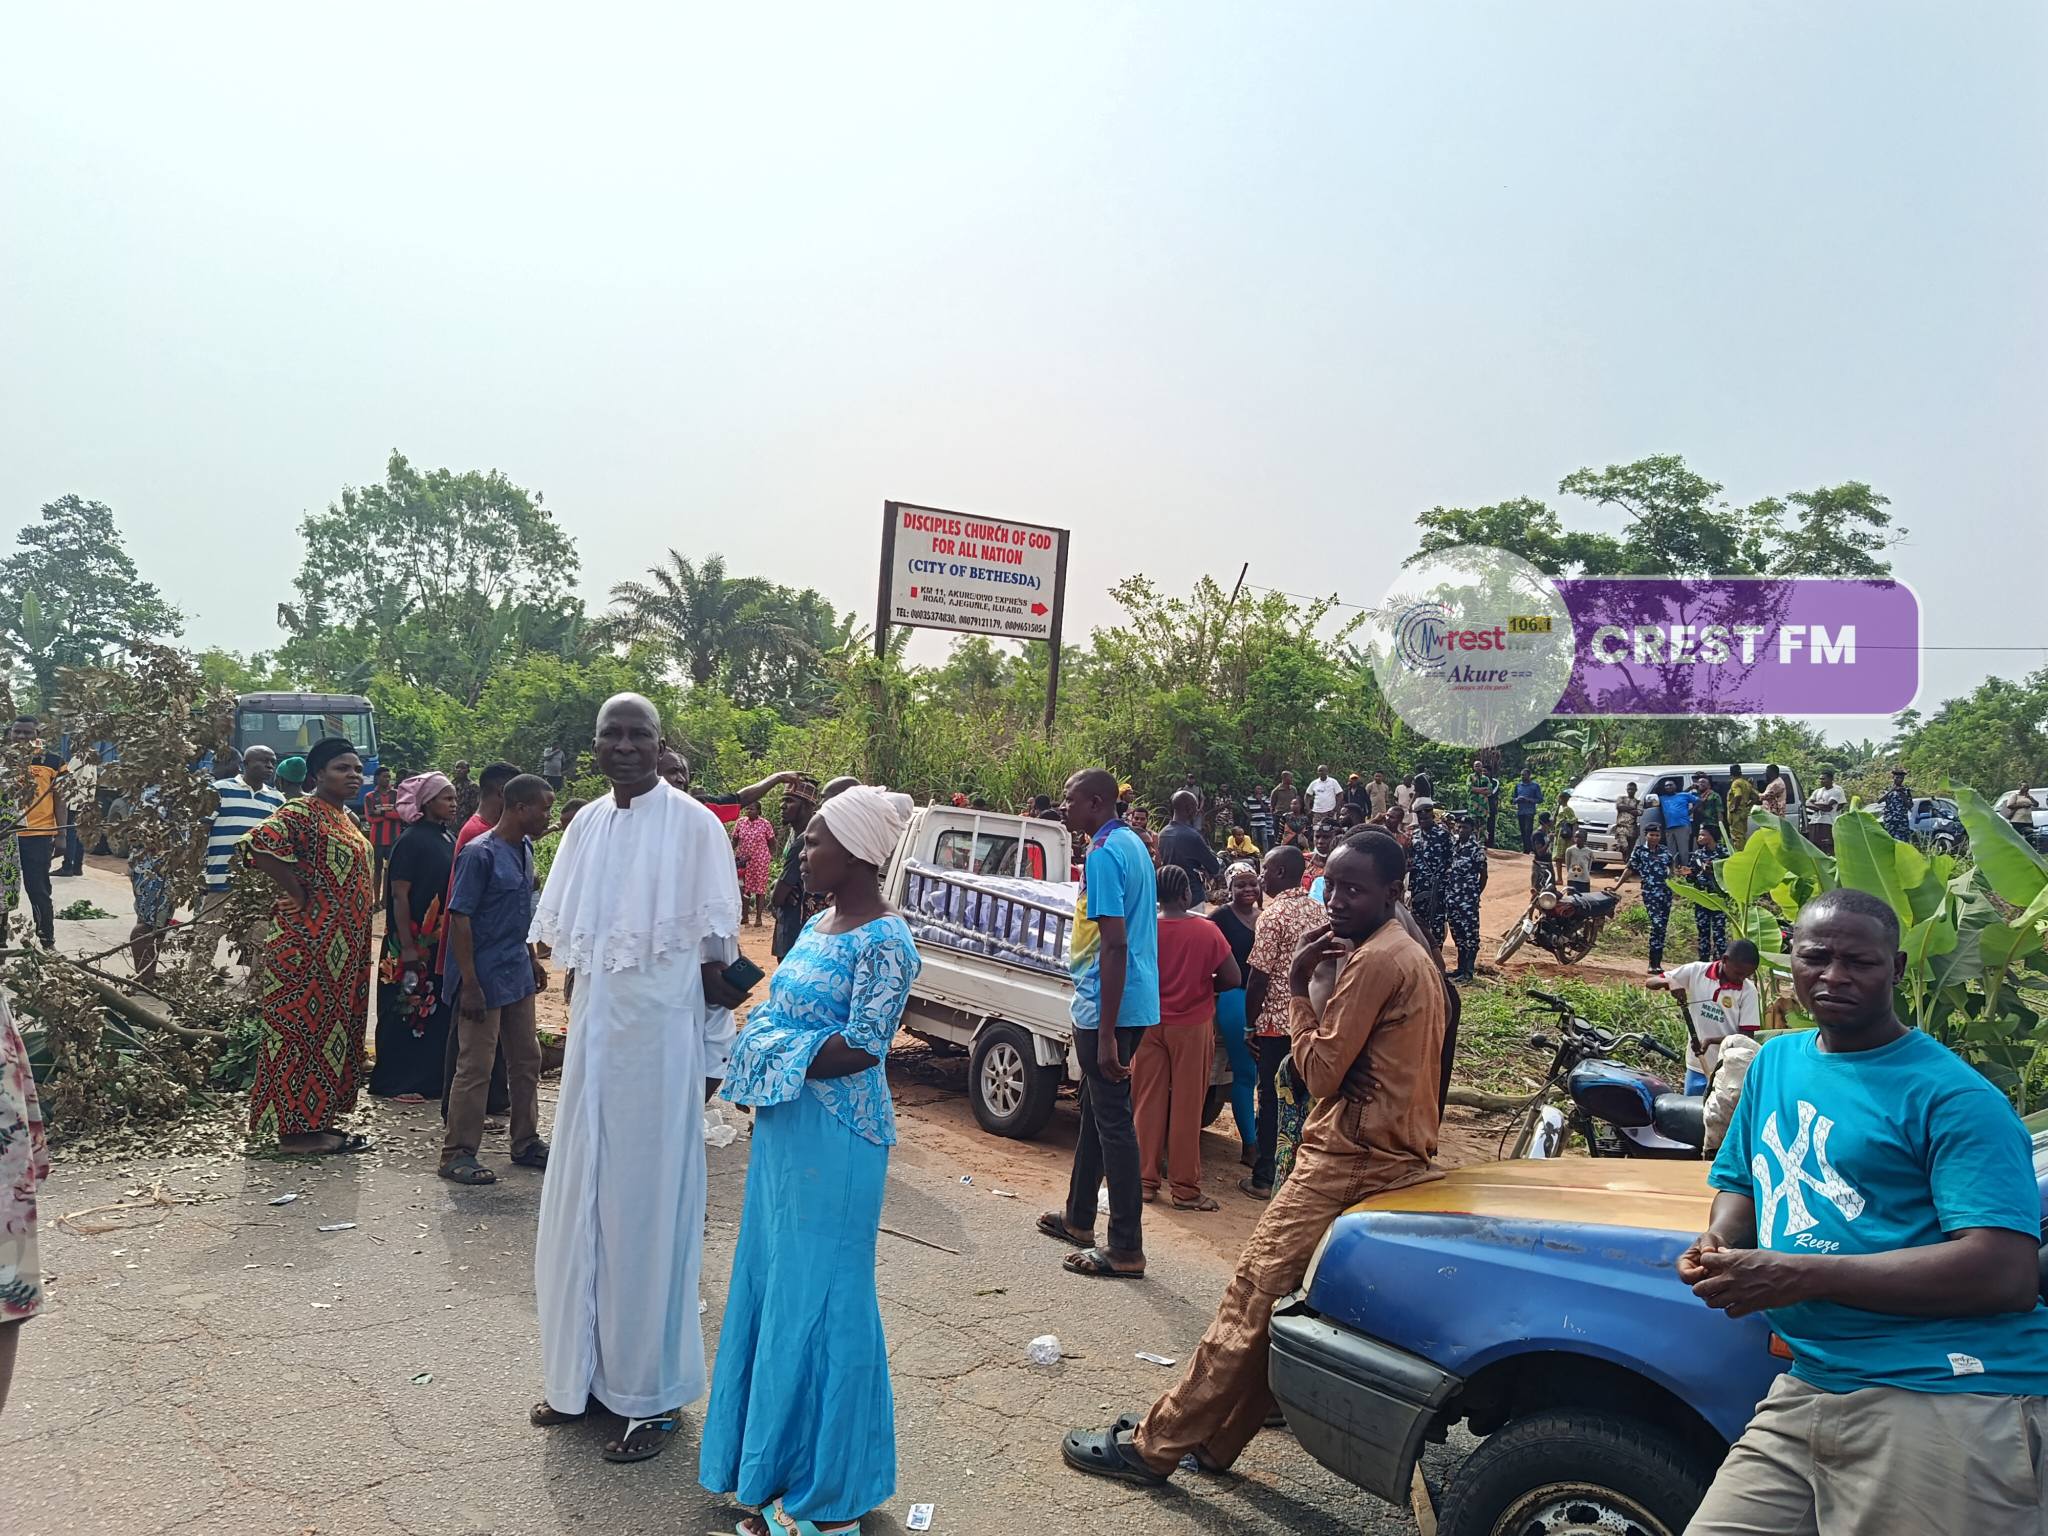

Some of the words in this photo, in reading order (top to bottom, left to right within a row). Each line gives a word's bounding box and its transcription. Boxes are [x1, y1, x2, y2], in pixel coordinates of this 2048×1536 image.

[903, 512, 961, 536] DISCIPLES
[964, 522, 1009, 543] CHURCH
[1012, 530, 1026, 546] OF
[1029, 532, 1051, 550] GOD
[932, 537, 955, 555] FOR
[958, 541, 977, 558] ALL
[981, 544, 1023, 565] NATION
[908, 559, 946, 574] (CITY
[949, 564, 967, 577] OF
[969, 567, 1041, 590] BETHESDA)
[920, 586, 933, 594] KM
[995, 595, 1028, 606] EXPRESS
[923, 595, 946, 605] ROAD,
[896, 607, 909, 618] TEL:
[1701, 1010, 1725, 1023] XMAS
[1702, 1003, 1724, 1016] MERRY
[1794, 1233, 1840, 1253] Reeze
